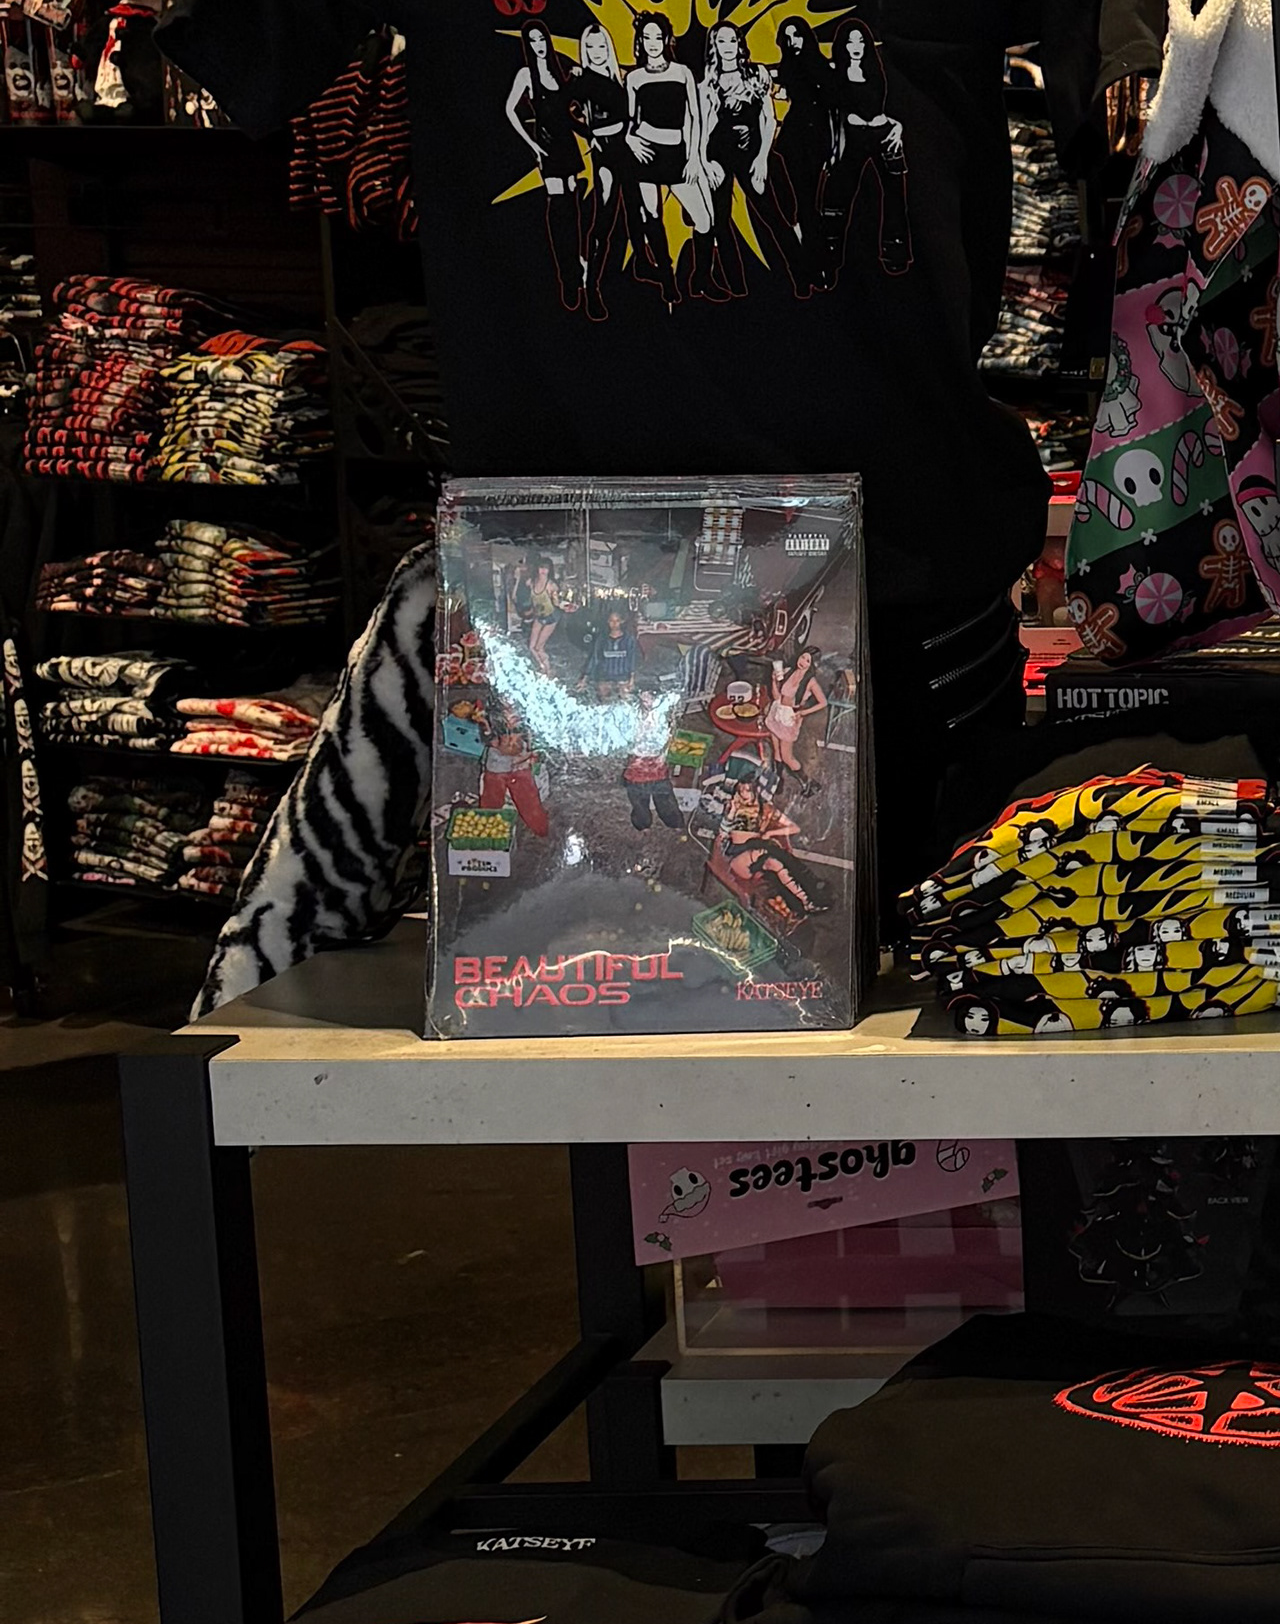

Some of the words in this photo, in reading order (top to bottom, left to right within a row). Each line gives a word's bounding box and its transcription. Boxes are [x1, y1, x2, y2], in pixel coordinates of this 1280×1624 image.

[1057, 688, 1100, 708] HOT
[1104, 688, 1169, 708] TOPIC
[1213, 868, 1243, 877] MEDIUM
[1225, 891, 1255, 899] MEDIUM
[454, 952, 683, 984] BEAUTIFUL
[454, 983, 632, 1008] CHAOS
[735, 981, 824, 1001] KATSEYE
[729, 1140, 917, 1197] ghostees
